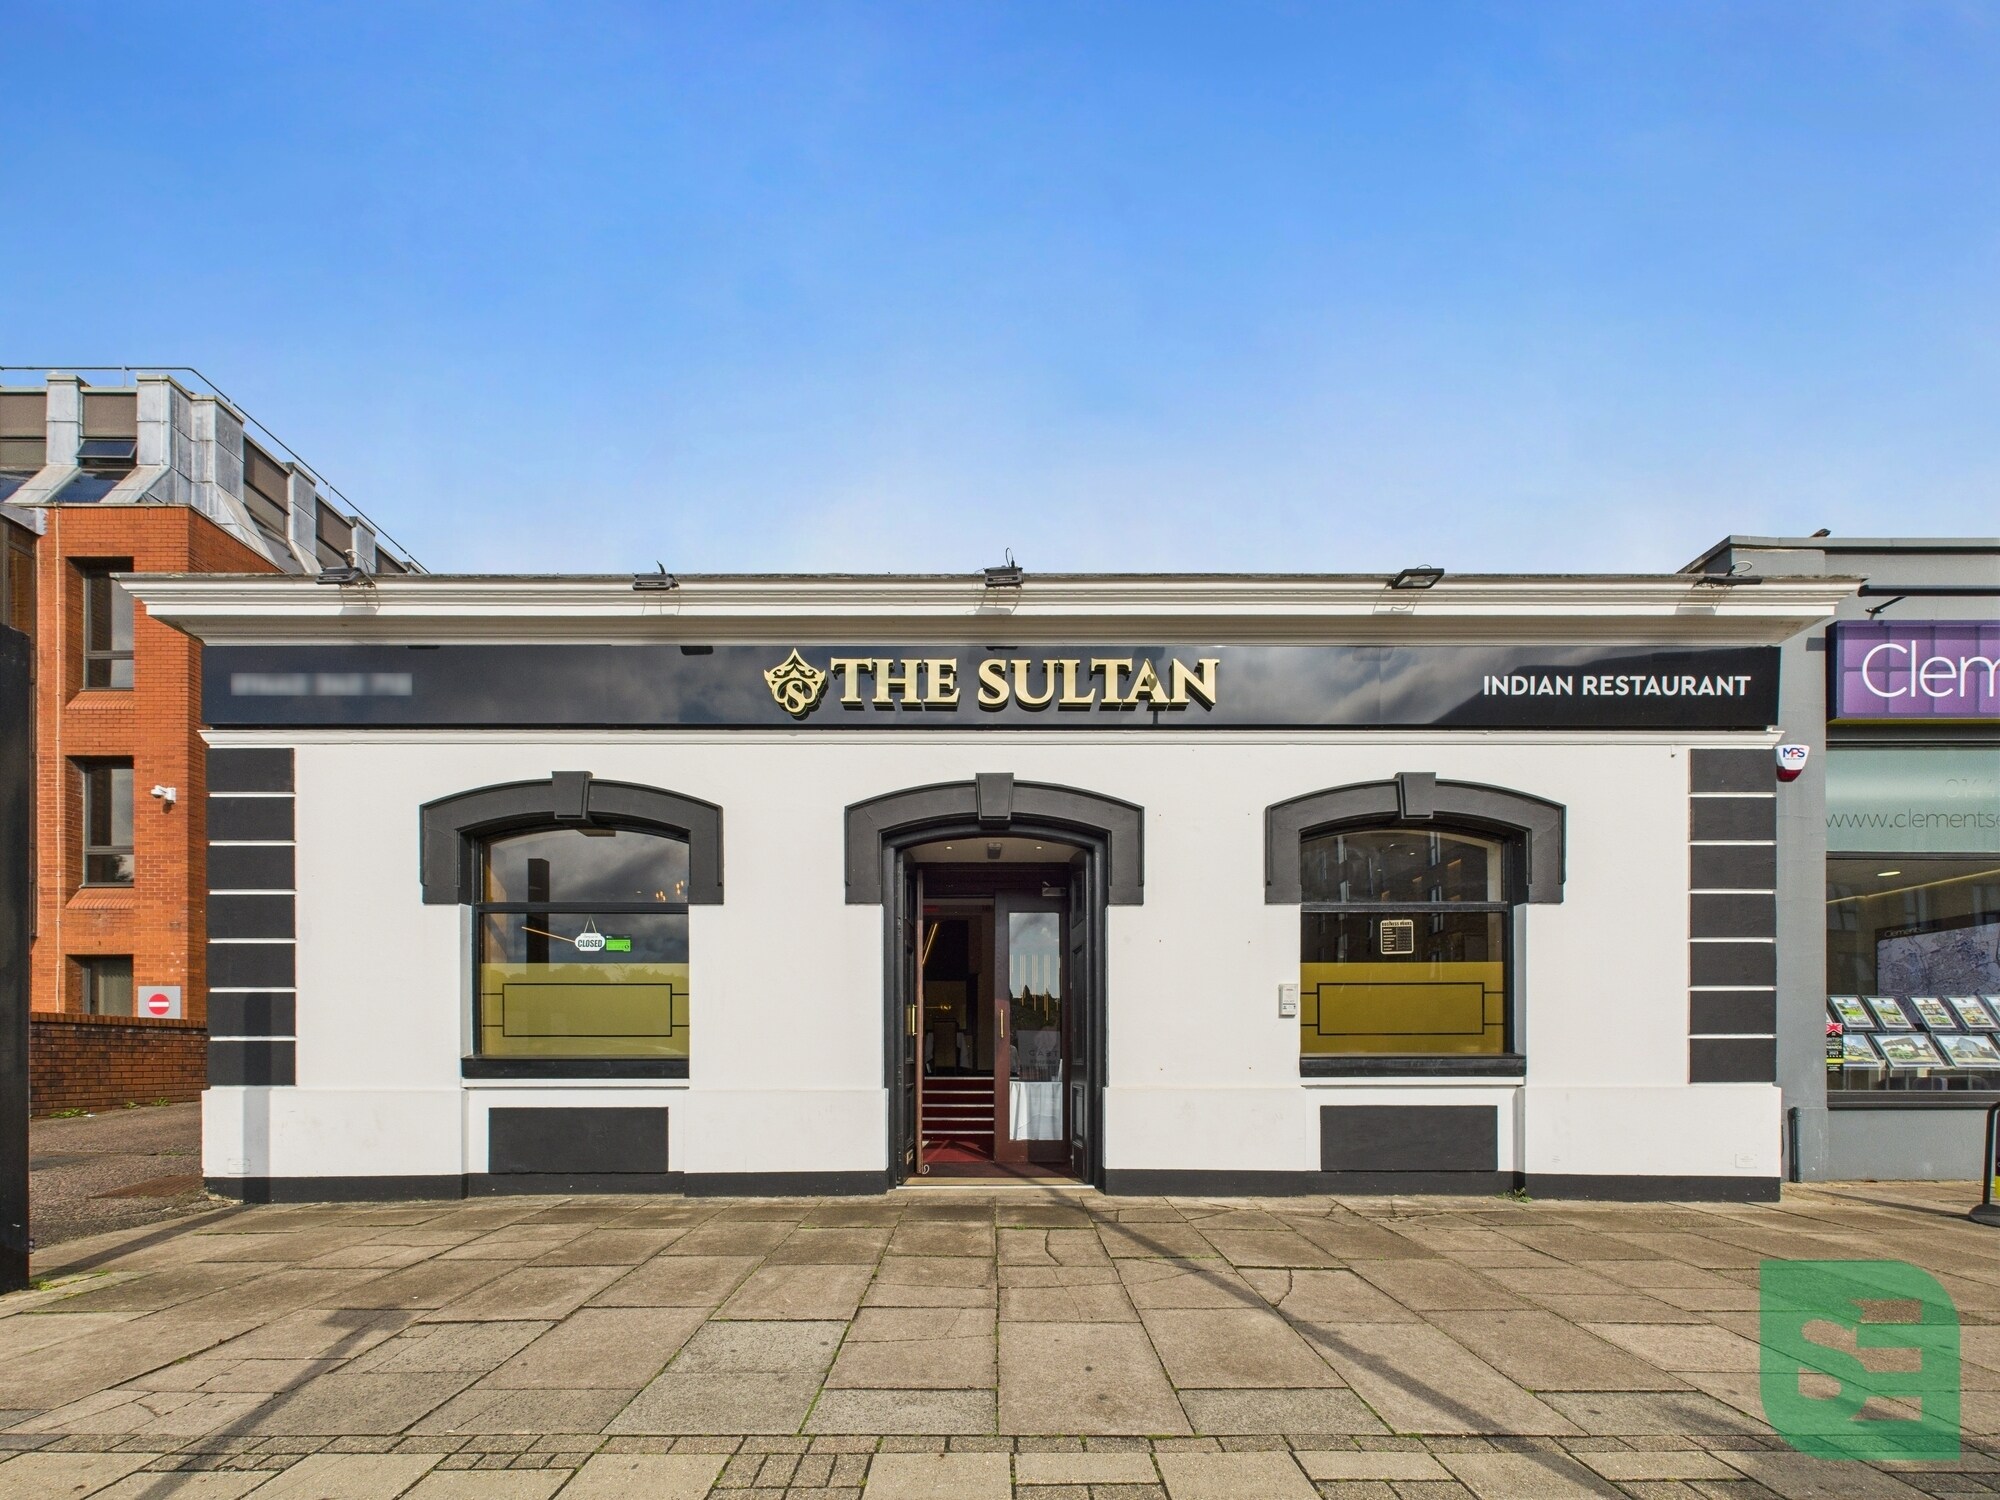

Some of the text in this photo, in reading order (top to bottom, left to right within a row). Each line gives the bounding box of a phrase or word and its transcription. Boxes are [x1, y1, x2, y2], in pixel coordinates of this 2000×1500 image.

[830, 657, 1220, 705] THE SULTAN
[1483, 675, 1751, 696] INDIAN RESTAURANT
[1862, 639, 2000, 698] Clem
[1782, 747, 1805, 758] MPS
